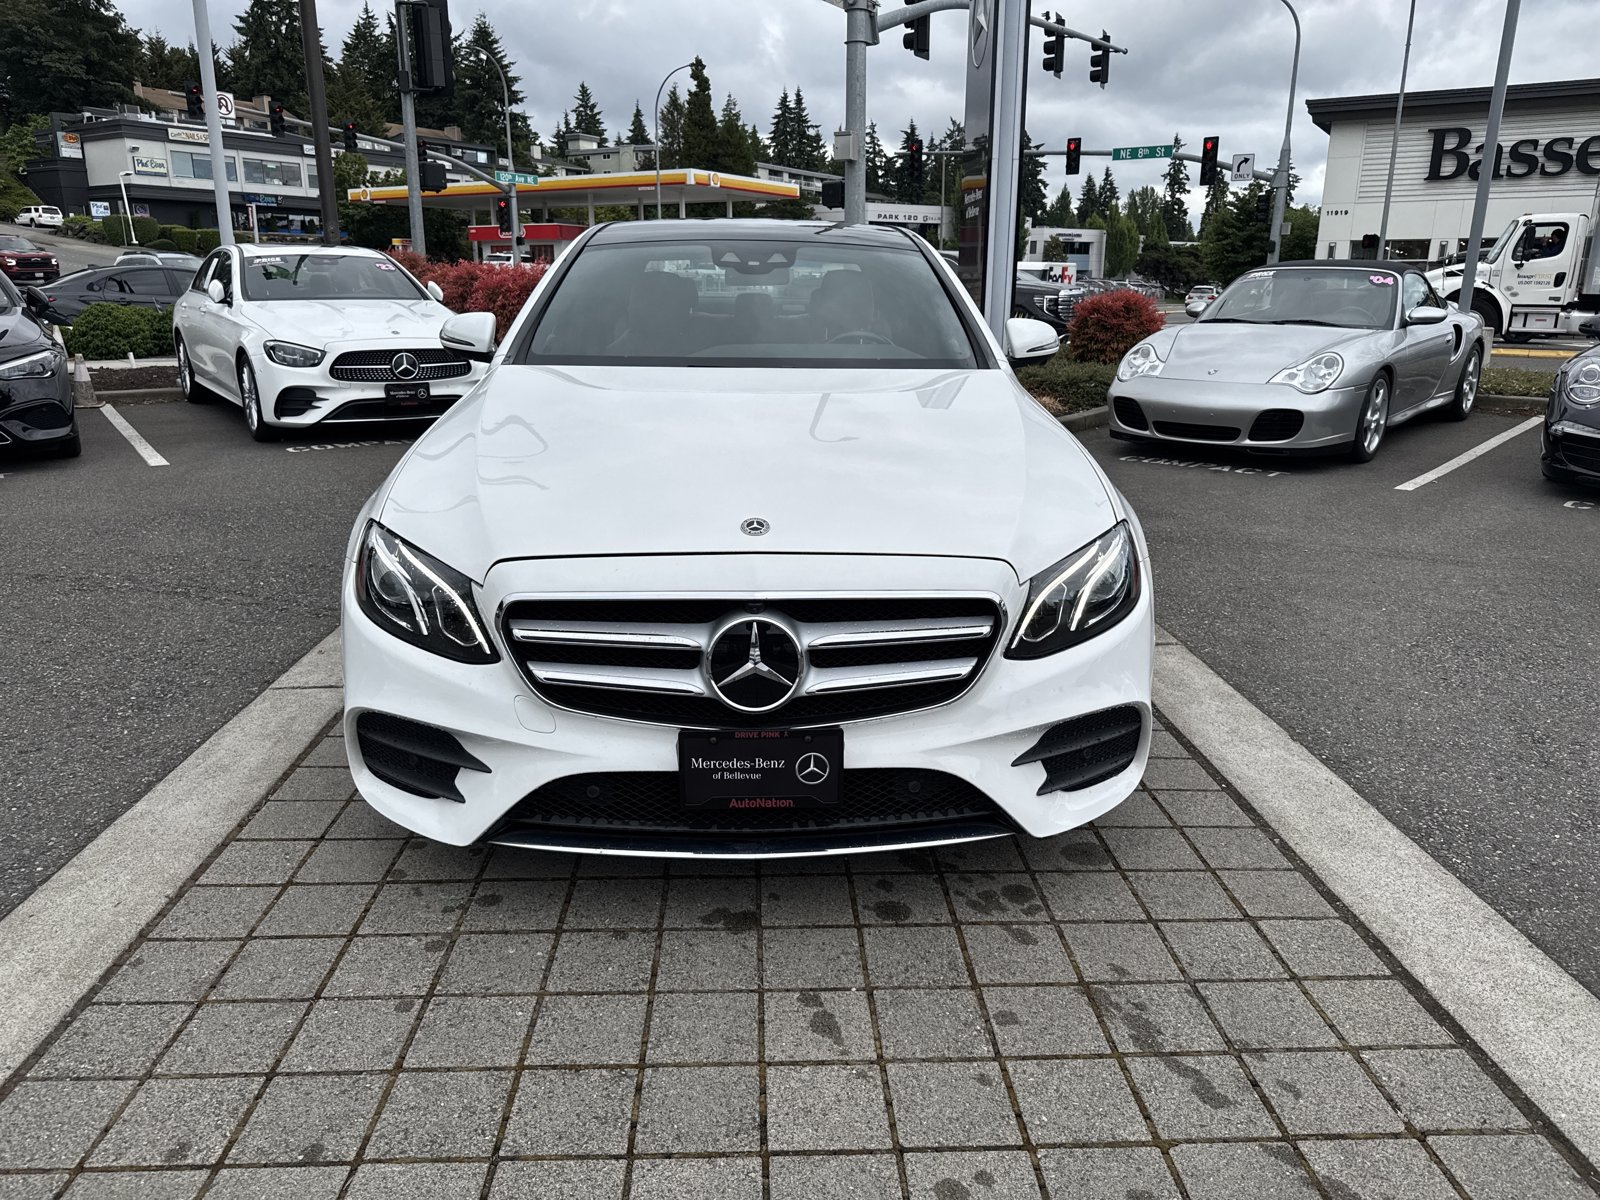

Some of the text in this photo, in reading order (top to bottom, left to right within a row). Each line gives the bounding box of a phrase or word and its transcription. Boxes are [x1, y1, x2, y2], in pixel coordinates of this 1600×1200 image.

[1119, 147, 1165, 159] NE 8th St
[1424, 127, 1600, 181] Basse
[877, 213, 900, 221] PARK
[1369, 275, 1394, 285] '04
[1119, 456, 1292, 477] COMPACT
[735, 731, 759, 739] DRIVE
[691, 757, 785, 769] Mercedes-Benz
[712, 771, 762, 780] of Bellevue
[729, 798, 794, 808] AutoNation
